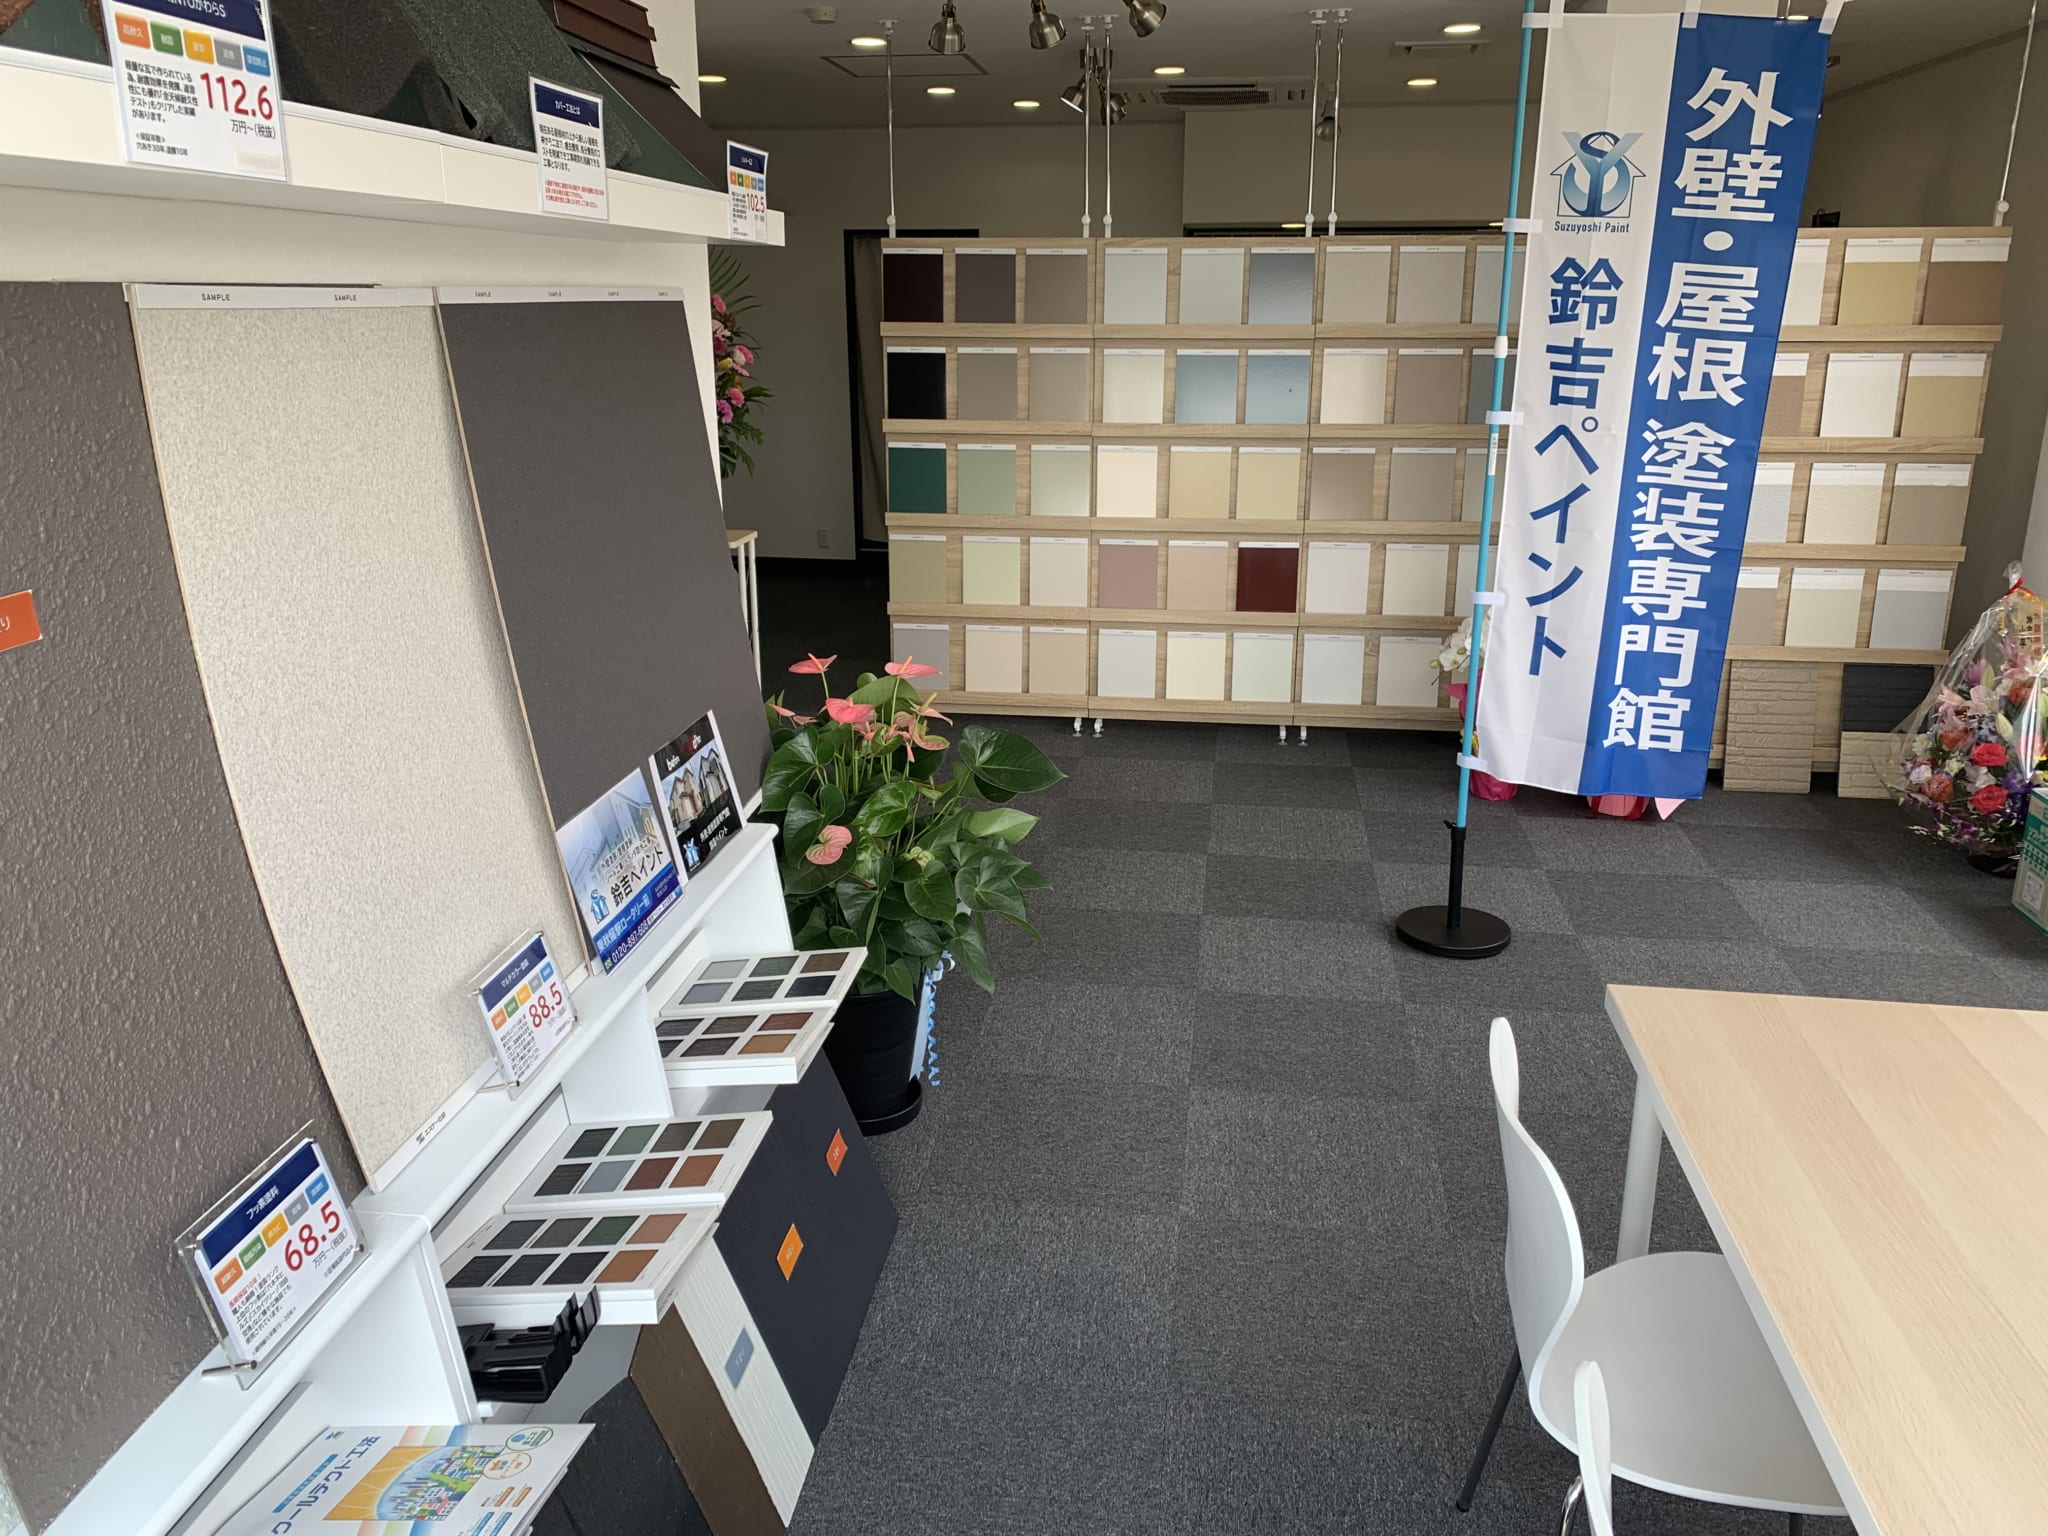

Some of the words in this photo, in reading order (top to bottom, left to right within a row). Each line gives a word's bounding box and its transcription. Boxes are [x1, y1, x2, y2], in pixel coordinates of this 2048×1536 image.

[200, 72, 273, 121] 112.6
[132, 108, 167, 124] があります。
[746, 192, 766, 214] 102.5
[1554, 220, 1601, 235] Suzuyoshi
[1604, 222, 1631, 234] Paint
[201, 293, 231, 302] SAMPLE
[334, 294, 357, 302] SAMPLE
[1526, 257, 1624, 676] 鈴吉ペイント
[529, 981, 563, 1029] 88.5
[246, 1185, 280, 1220] フッ素塗料
[284, 1199, 340, 1272] 68.5
[271, 1436, 382, 1535] クールテクト工法
